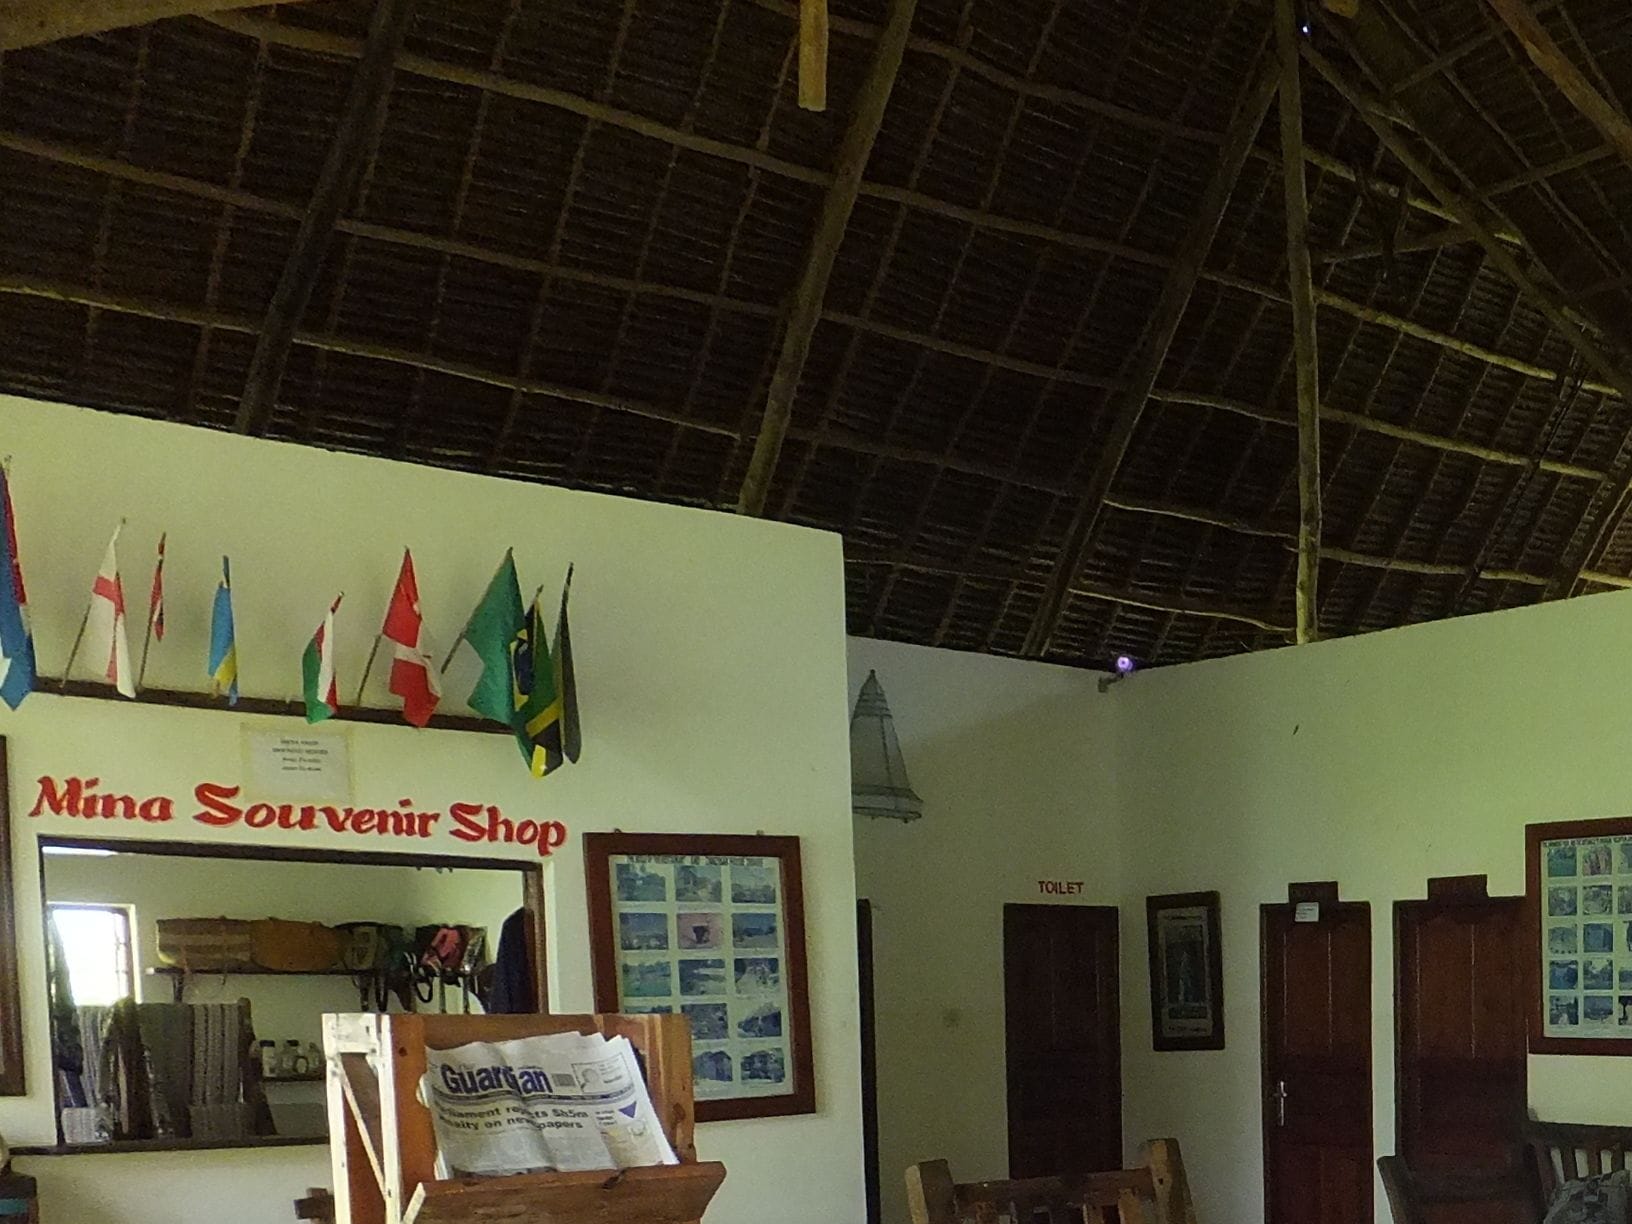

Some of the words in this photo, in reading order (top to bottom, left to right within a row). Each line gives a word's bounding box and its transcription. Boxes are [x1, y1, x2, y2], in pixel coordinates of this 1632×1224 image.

[29, 776, 174, 822] Mina
[193, 782, 440, 838] Souvenir
[448, 802, 568, 856] Shop
[1038, 881, 1084, 894] TOILET
[440, 1062, 553, 1094] Guardan
[440, 1115, 479, 1130] alty
[484, 1120, 502, 1129] on
